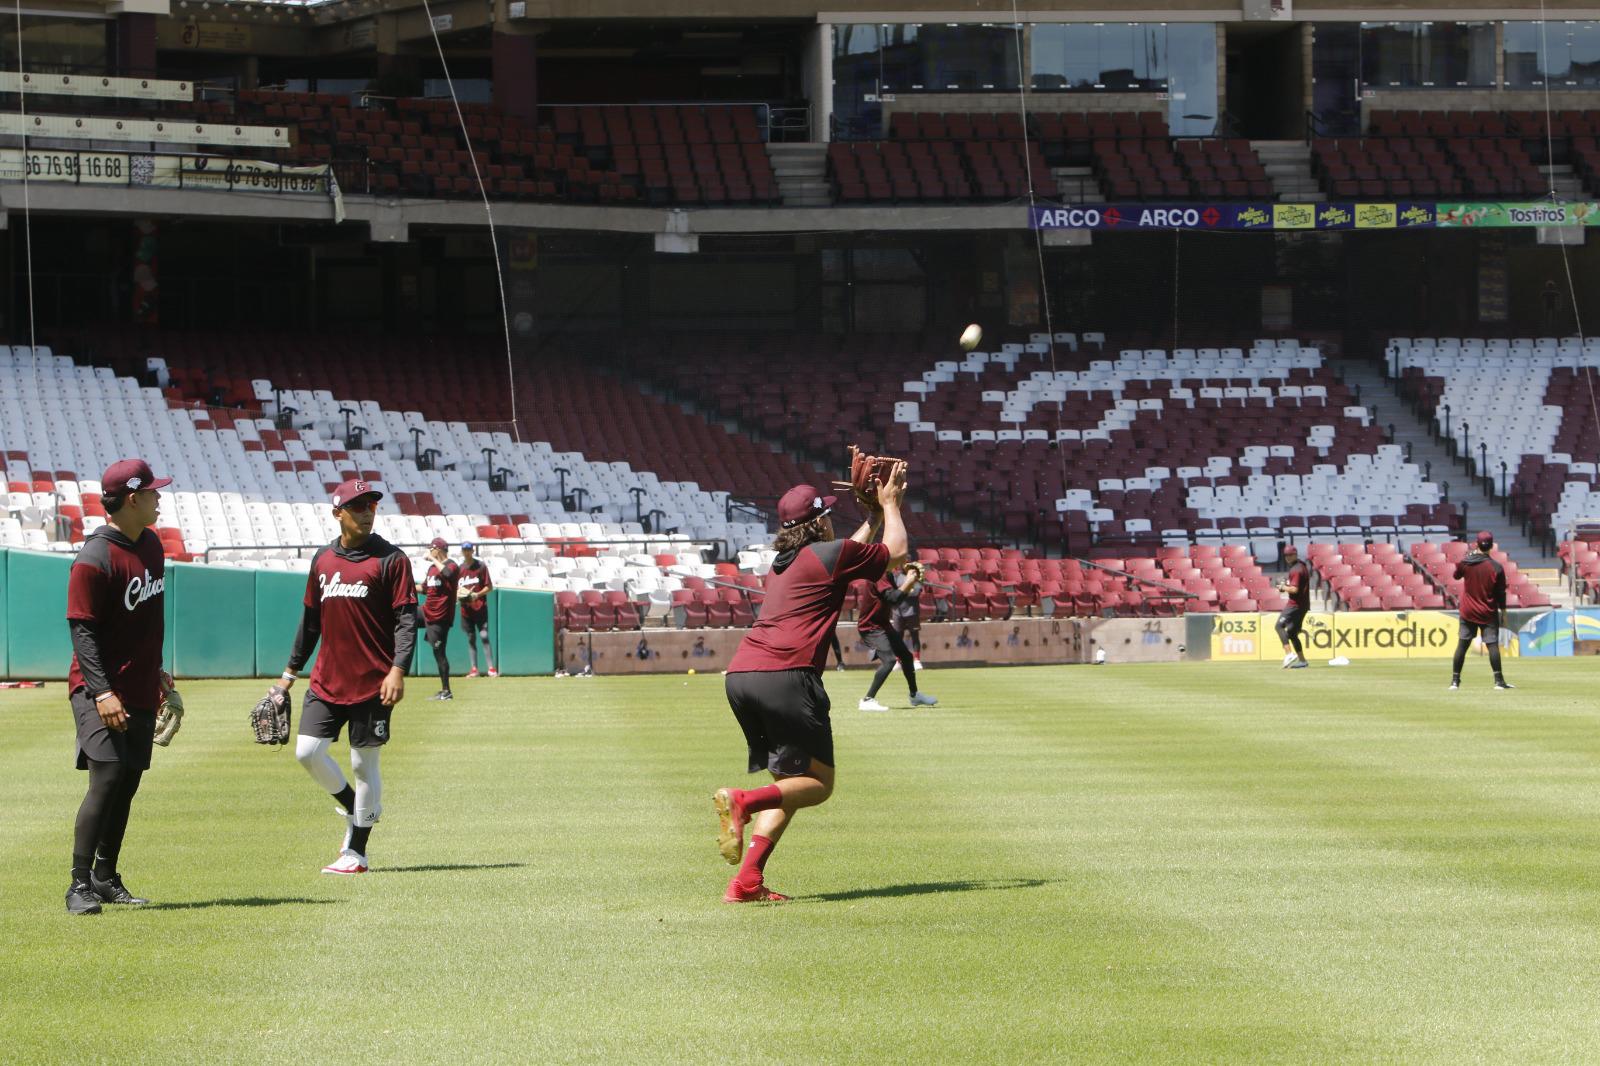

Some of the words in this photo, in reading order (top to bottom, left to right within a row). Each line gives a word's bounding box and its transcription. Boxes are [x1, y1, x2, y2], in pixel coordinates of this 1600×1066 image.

[44, 155, 62, 175] 76
[86, 157, 101, 177] 16
[105, 158, 121, 178] 68
[1040, 209, 1100, 227] ARCO
[1139, 208, 1199, 227] ARCO
[1223, 636, 1253, 654] fm
